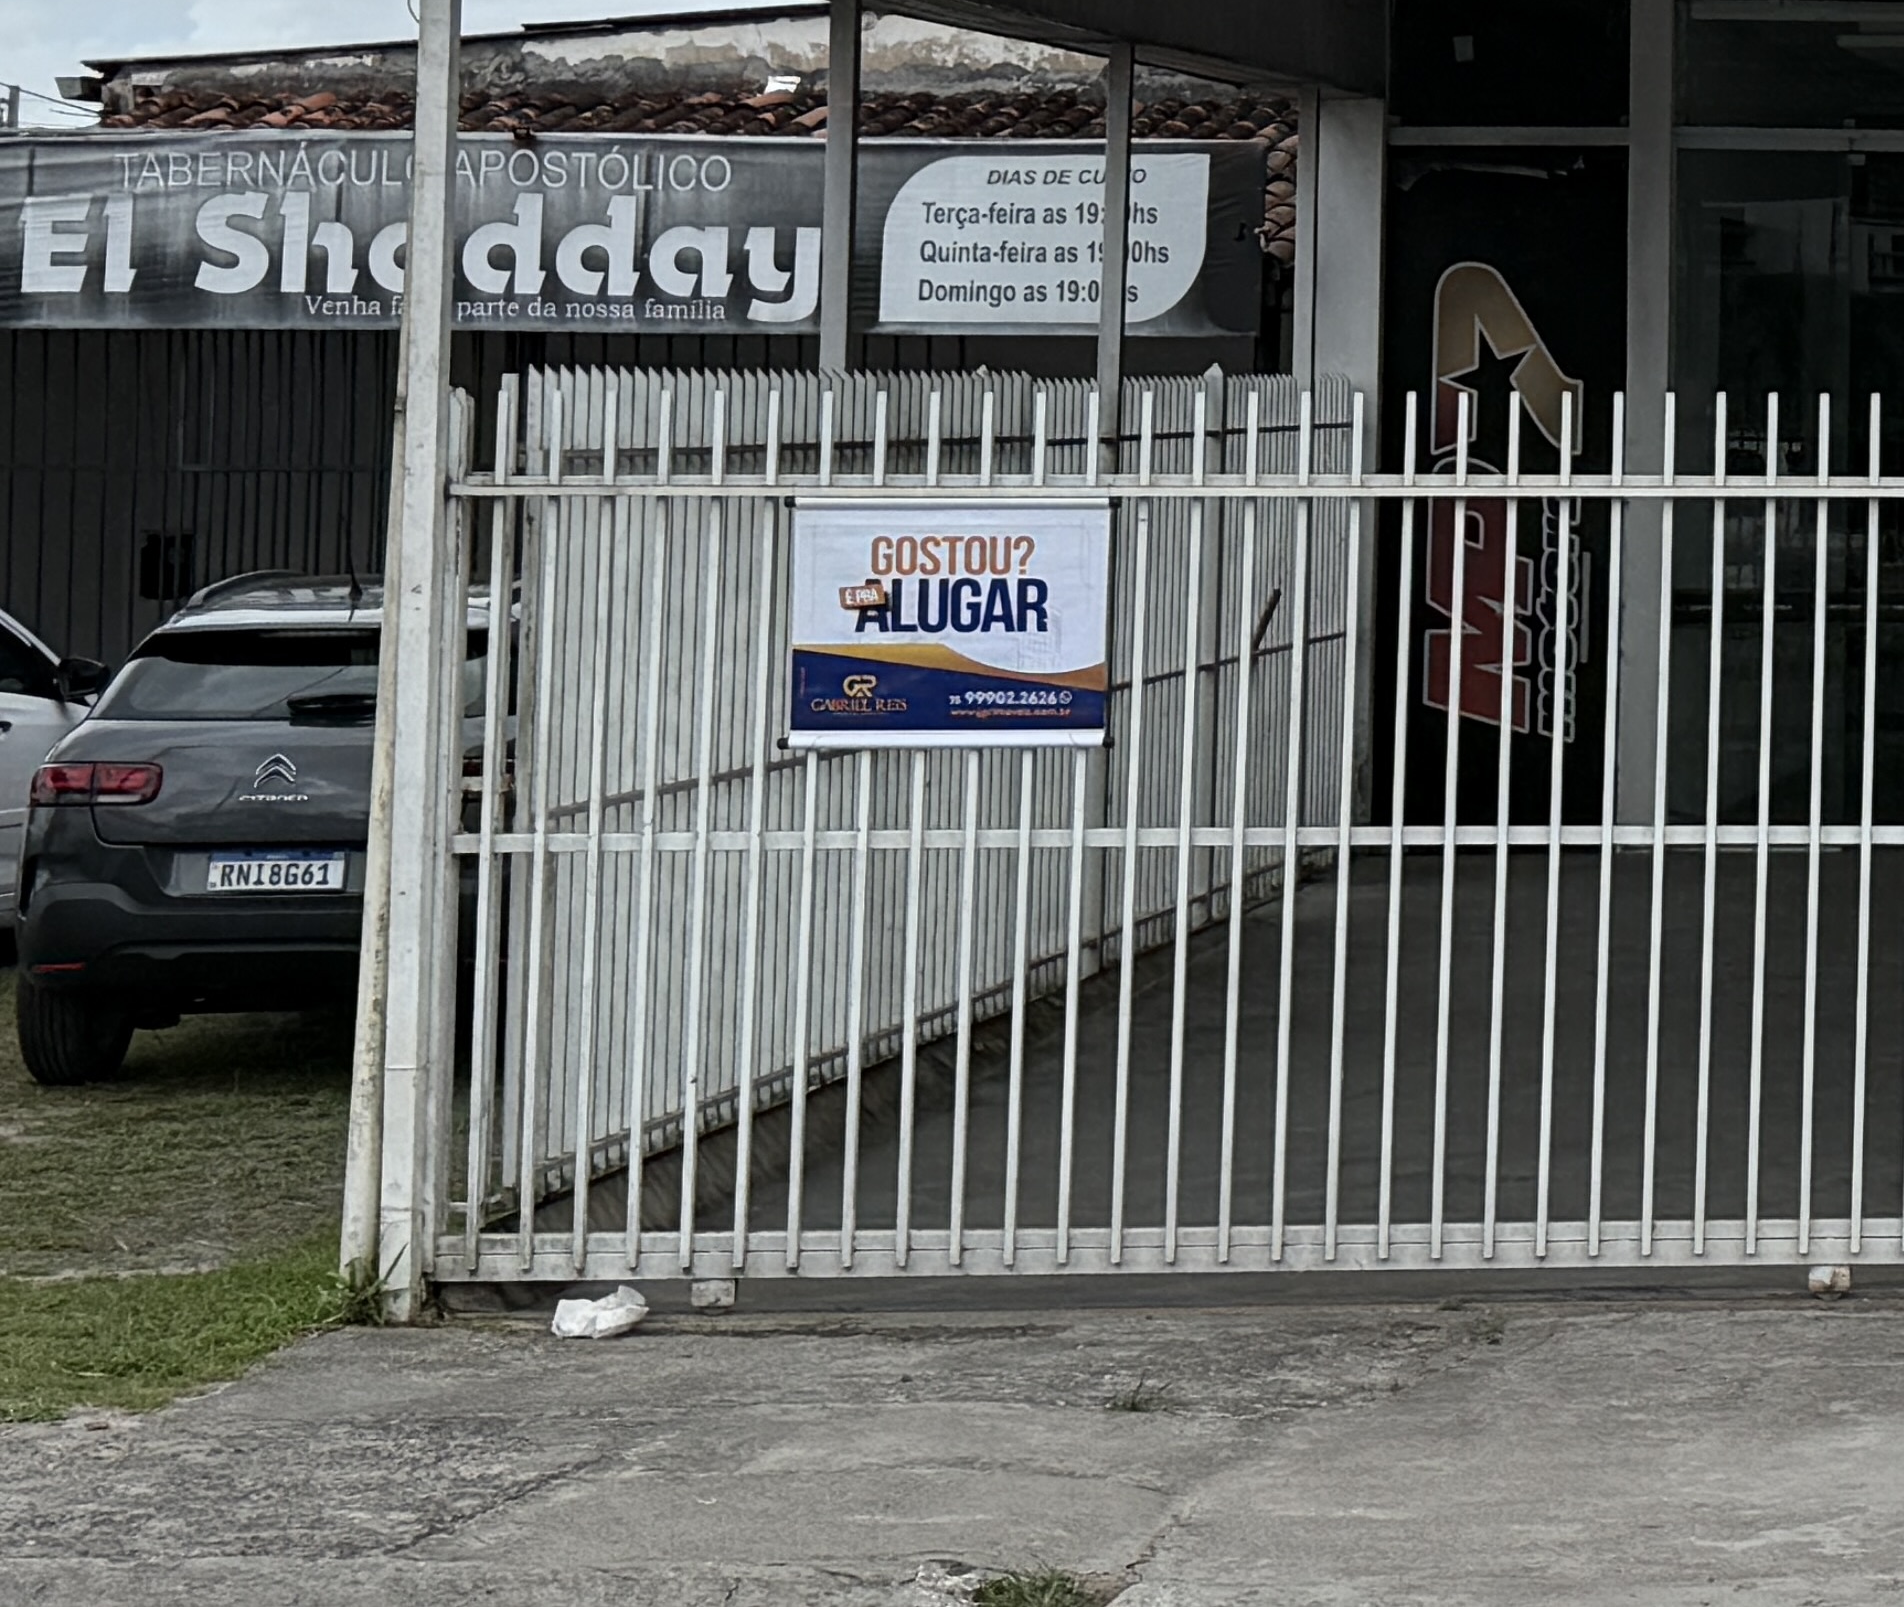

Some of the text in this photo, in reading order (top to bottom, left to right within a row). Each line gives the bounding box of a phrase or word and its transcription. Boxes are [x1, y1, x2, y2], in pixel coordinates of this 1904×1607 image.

[115, 141, 732, 191] TABERNÁCUL APOSTÓLICO
[986, 168, 1147, 185] DIAS DE CUO
[922, 201, 1158, 229] Terça-feira as 19:hs
[19, 193, 137, 293] El
[920, 240, 1047, 264] Quinta-feira
[1054, 245, 1078, 263] as
[918, 279, 1139, 308] Domingo as 19:0s
[306, 295, 381, 317] Venha
[457, 298, 519, 322] parte
[527, 297, 557, 319] da
[565, 301, 635, 320] nossa
[871, 535, 1035, 575] GOSTOU?
[855, 578, 1048, 632] ALUGAR
[964, 691, 1057, 705] 99902.2626
[220, 863, 330, 887] RNI8G61
